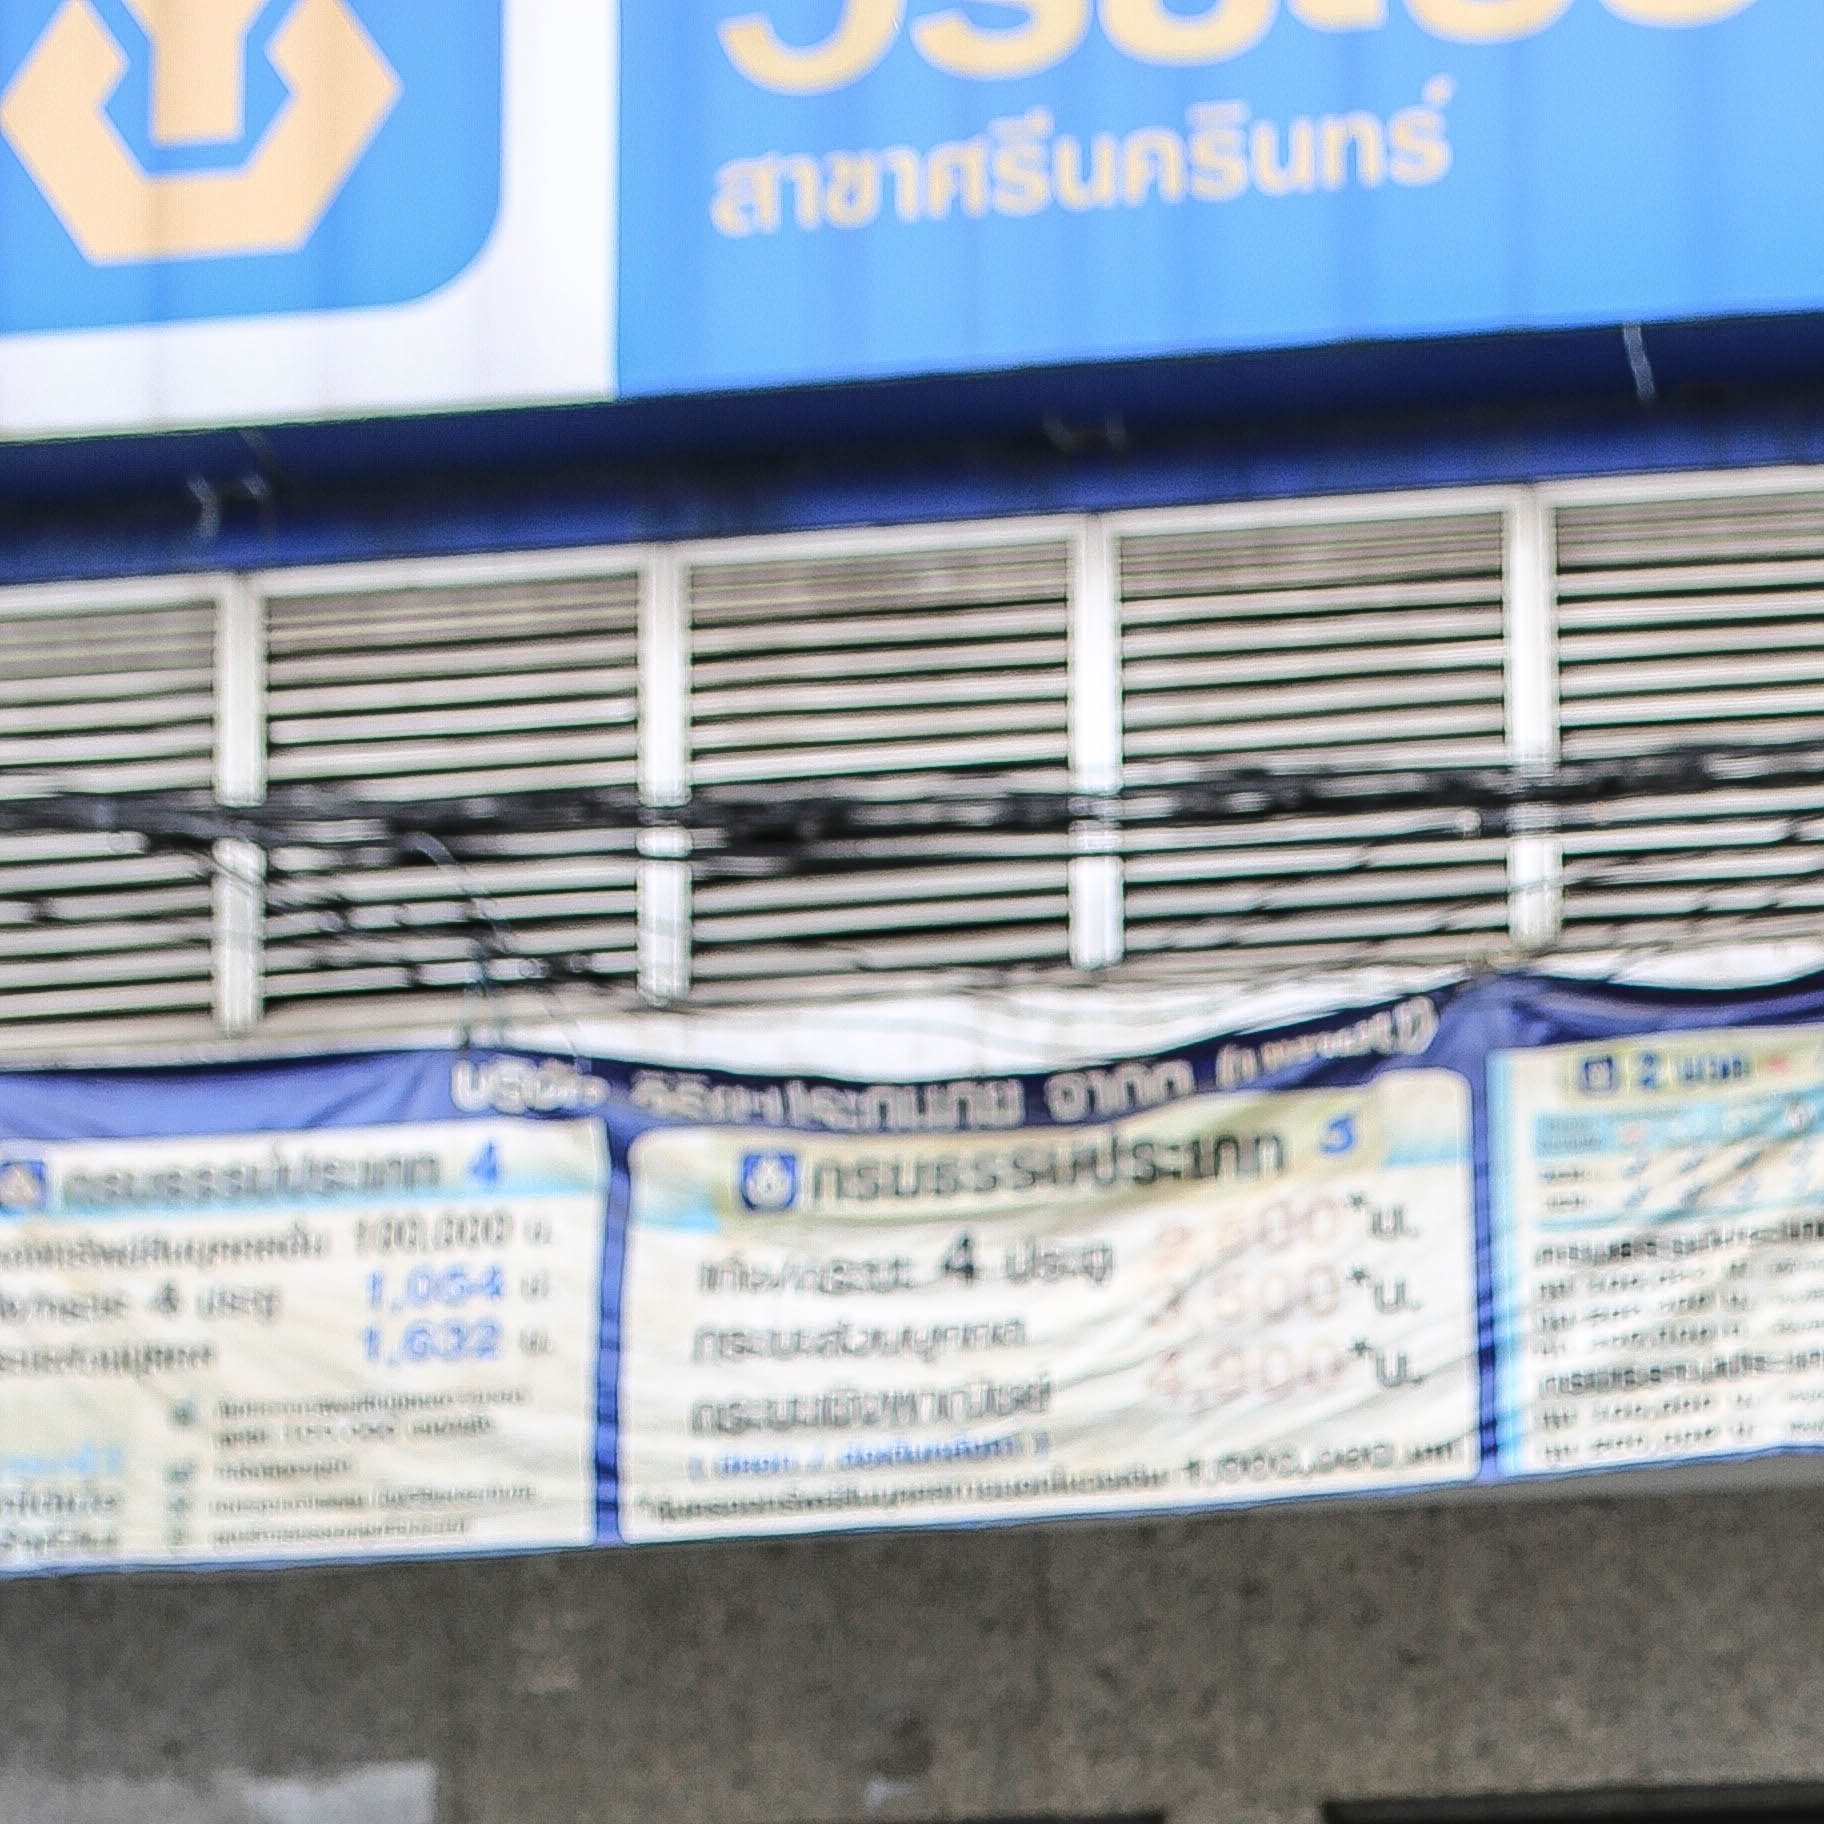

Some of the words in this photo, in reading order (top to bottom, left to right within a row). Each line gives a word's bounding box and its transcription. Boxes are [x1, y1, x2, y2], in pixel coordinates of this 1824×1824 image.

[710, 76, 1454, 236] สาขาศรีนครินทร์
[1320, 1112, 1357, 1157] 3
[468, 1139, 501, 1184] 4
[945, 1232, 974, 1286] 4
